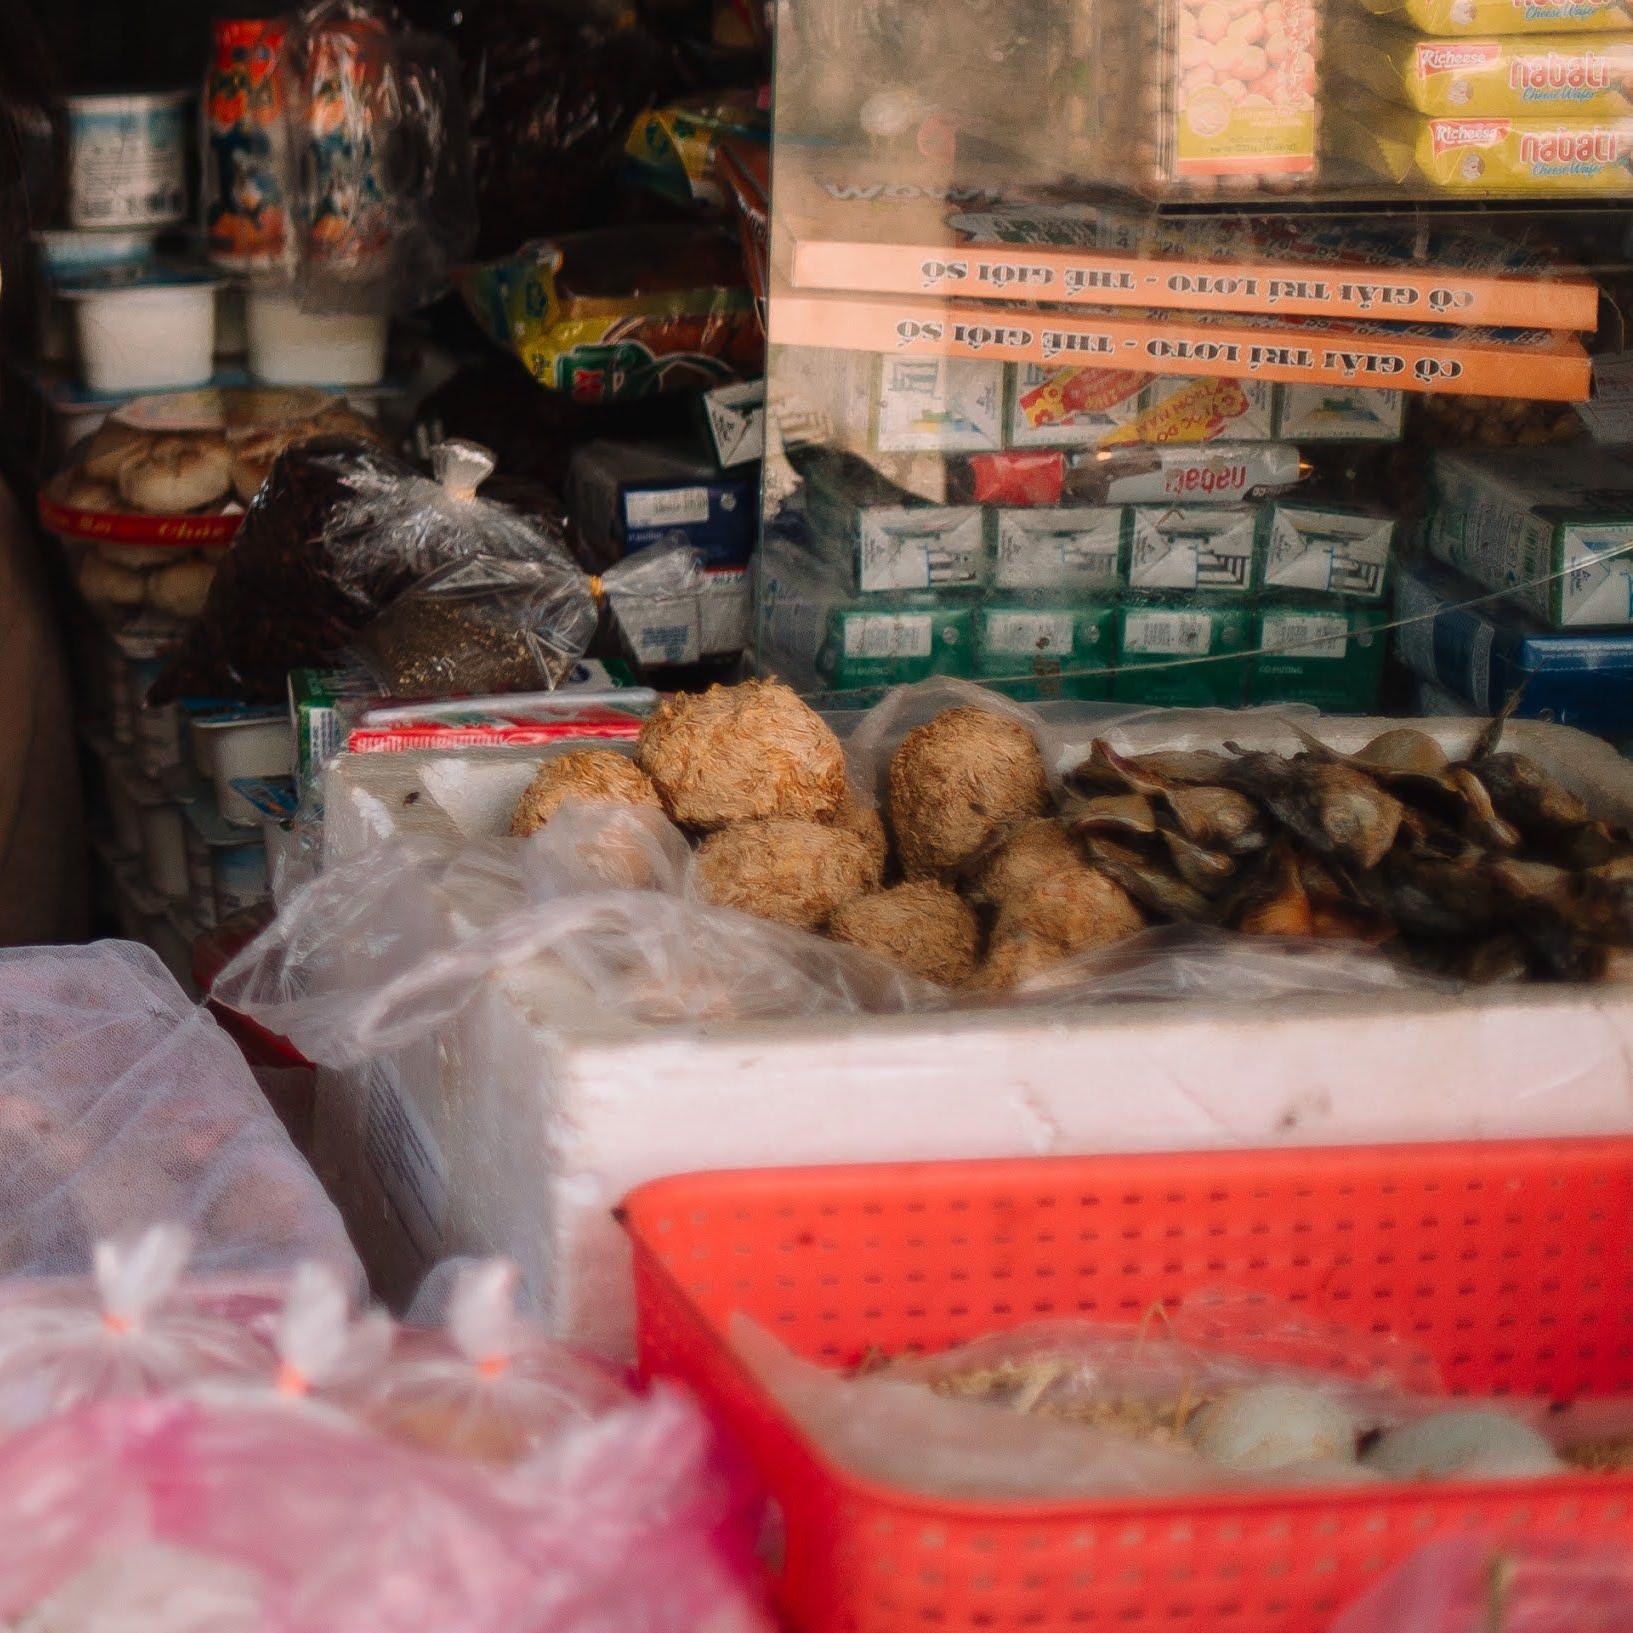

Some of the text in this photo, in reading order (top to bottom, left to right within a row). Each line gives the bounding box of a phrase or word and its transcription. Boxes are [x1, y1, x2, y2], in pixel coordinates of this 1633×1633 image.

[1422, 51, 1486, 68] Richeese
[1435, 126, 1499, 144] Richeese
[1520, 126, 1618, 163] nabati
